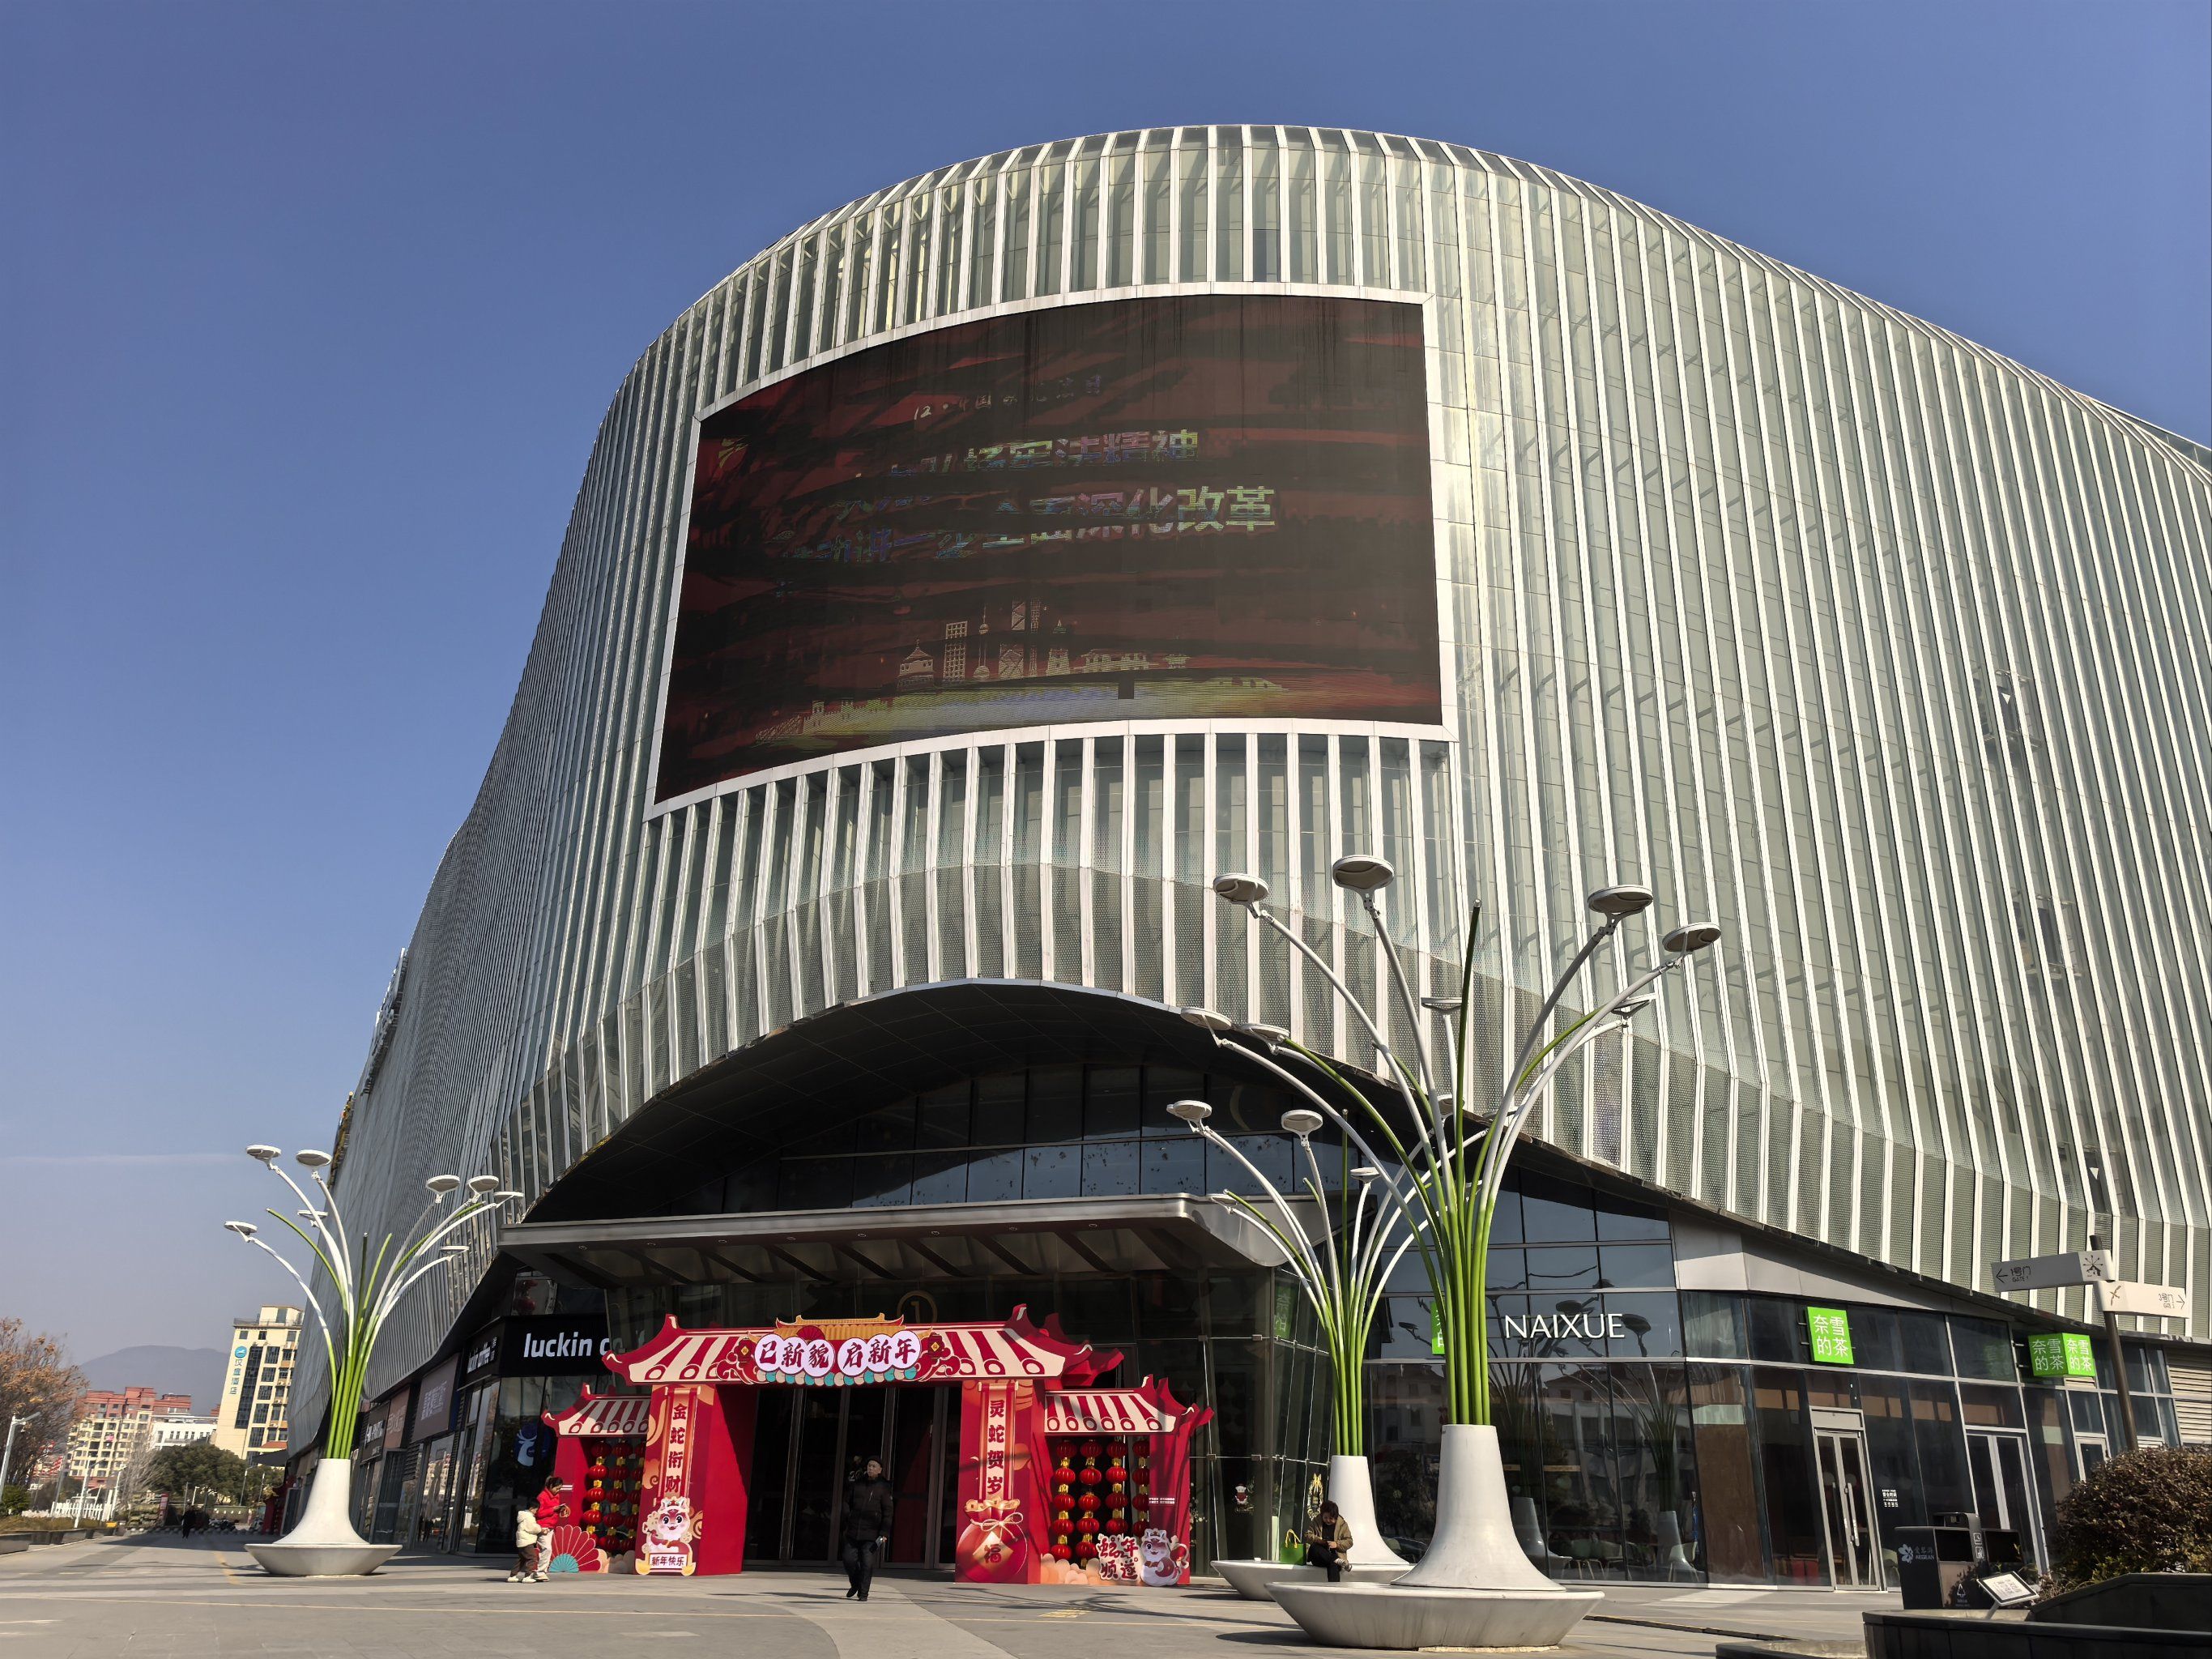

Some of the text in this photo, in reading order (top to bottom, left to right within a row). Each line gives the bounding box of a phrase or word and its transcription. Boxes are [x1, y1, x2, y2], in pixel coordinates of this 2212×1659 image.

[1505, 1313, 1626, 1339] NAIXUE
[1813, 1314, 1845, 1337] 奈雪
[523, 1332, 593, 1358] luckin
[1816, 1336, 1849, 1358] 的茶
[2032, 1338, 2061, 1354] 奈雪
[2066, 1337, 2090, 1355] 奈雪
[2035, 1354, 2065, 1371] 的茶
[2069, 1355, 2092, 1371] 的茶
[987, 1399, 1005, 1495] 灵蛇贺岁
[651, 1555, 684, 1567] 新年快乐
